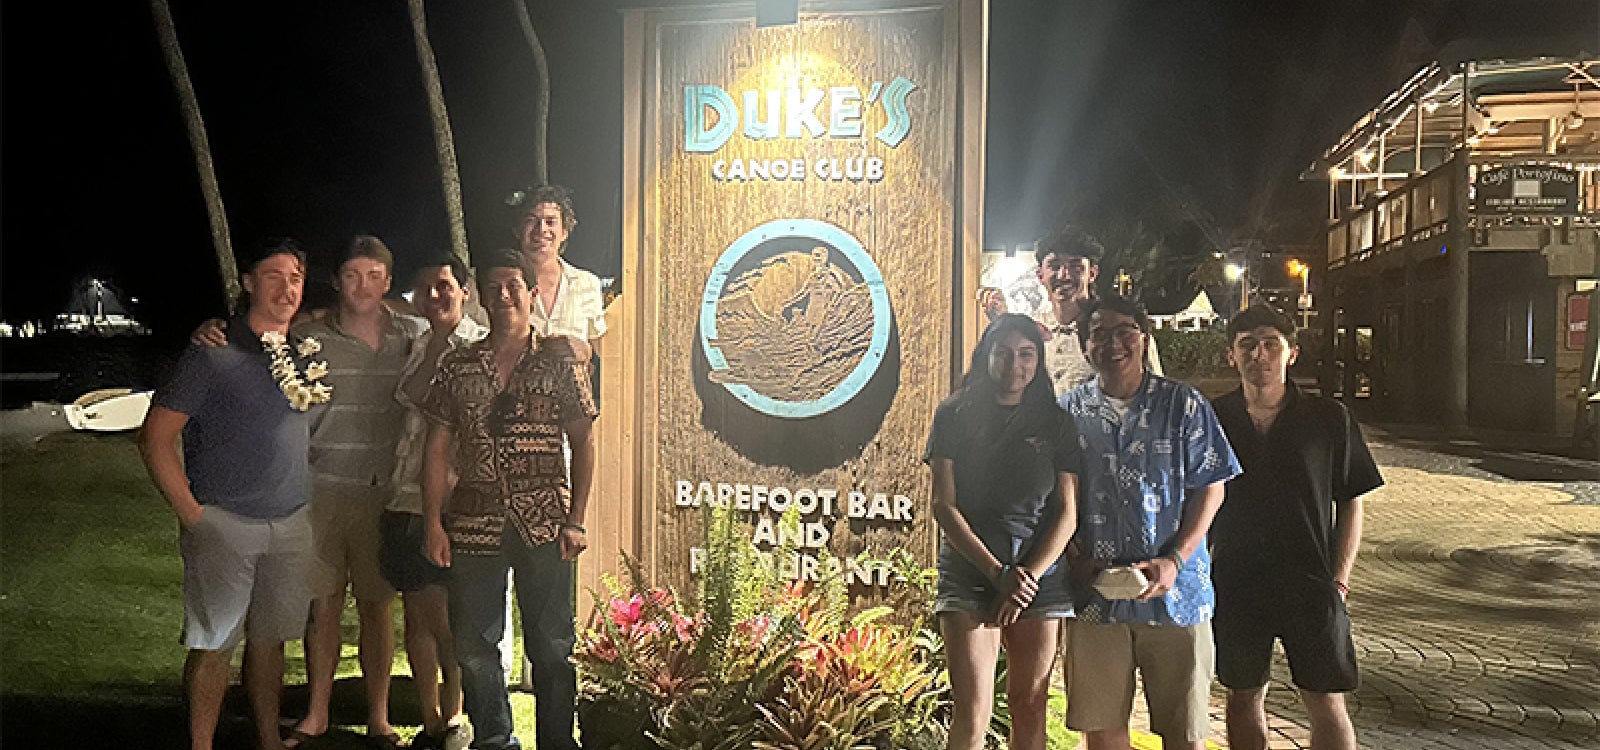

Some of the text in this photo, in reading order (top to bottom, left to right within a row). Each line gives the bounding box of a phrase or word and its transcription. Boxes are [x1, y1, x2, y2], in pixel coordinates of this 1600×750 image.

[684, 76, 917, 153] DUKE'S
[712, 156, 884, 182] CANOE CLUB
[675, 480, 914, 521] BAREFOOT BAR
[753, 518, 830, 548] AND
